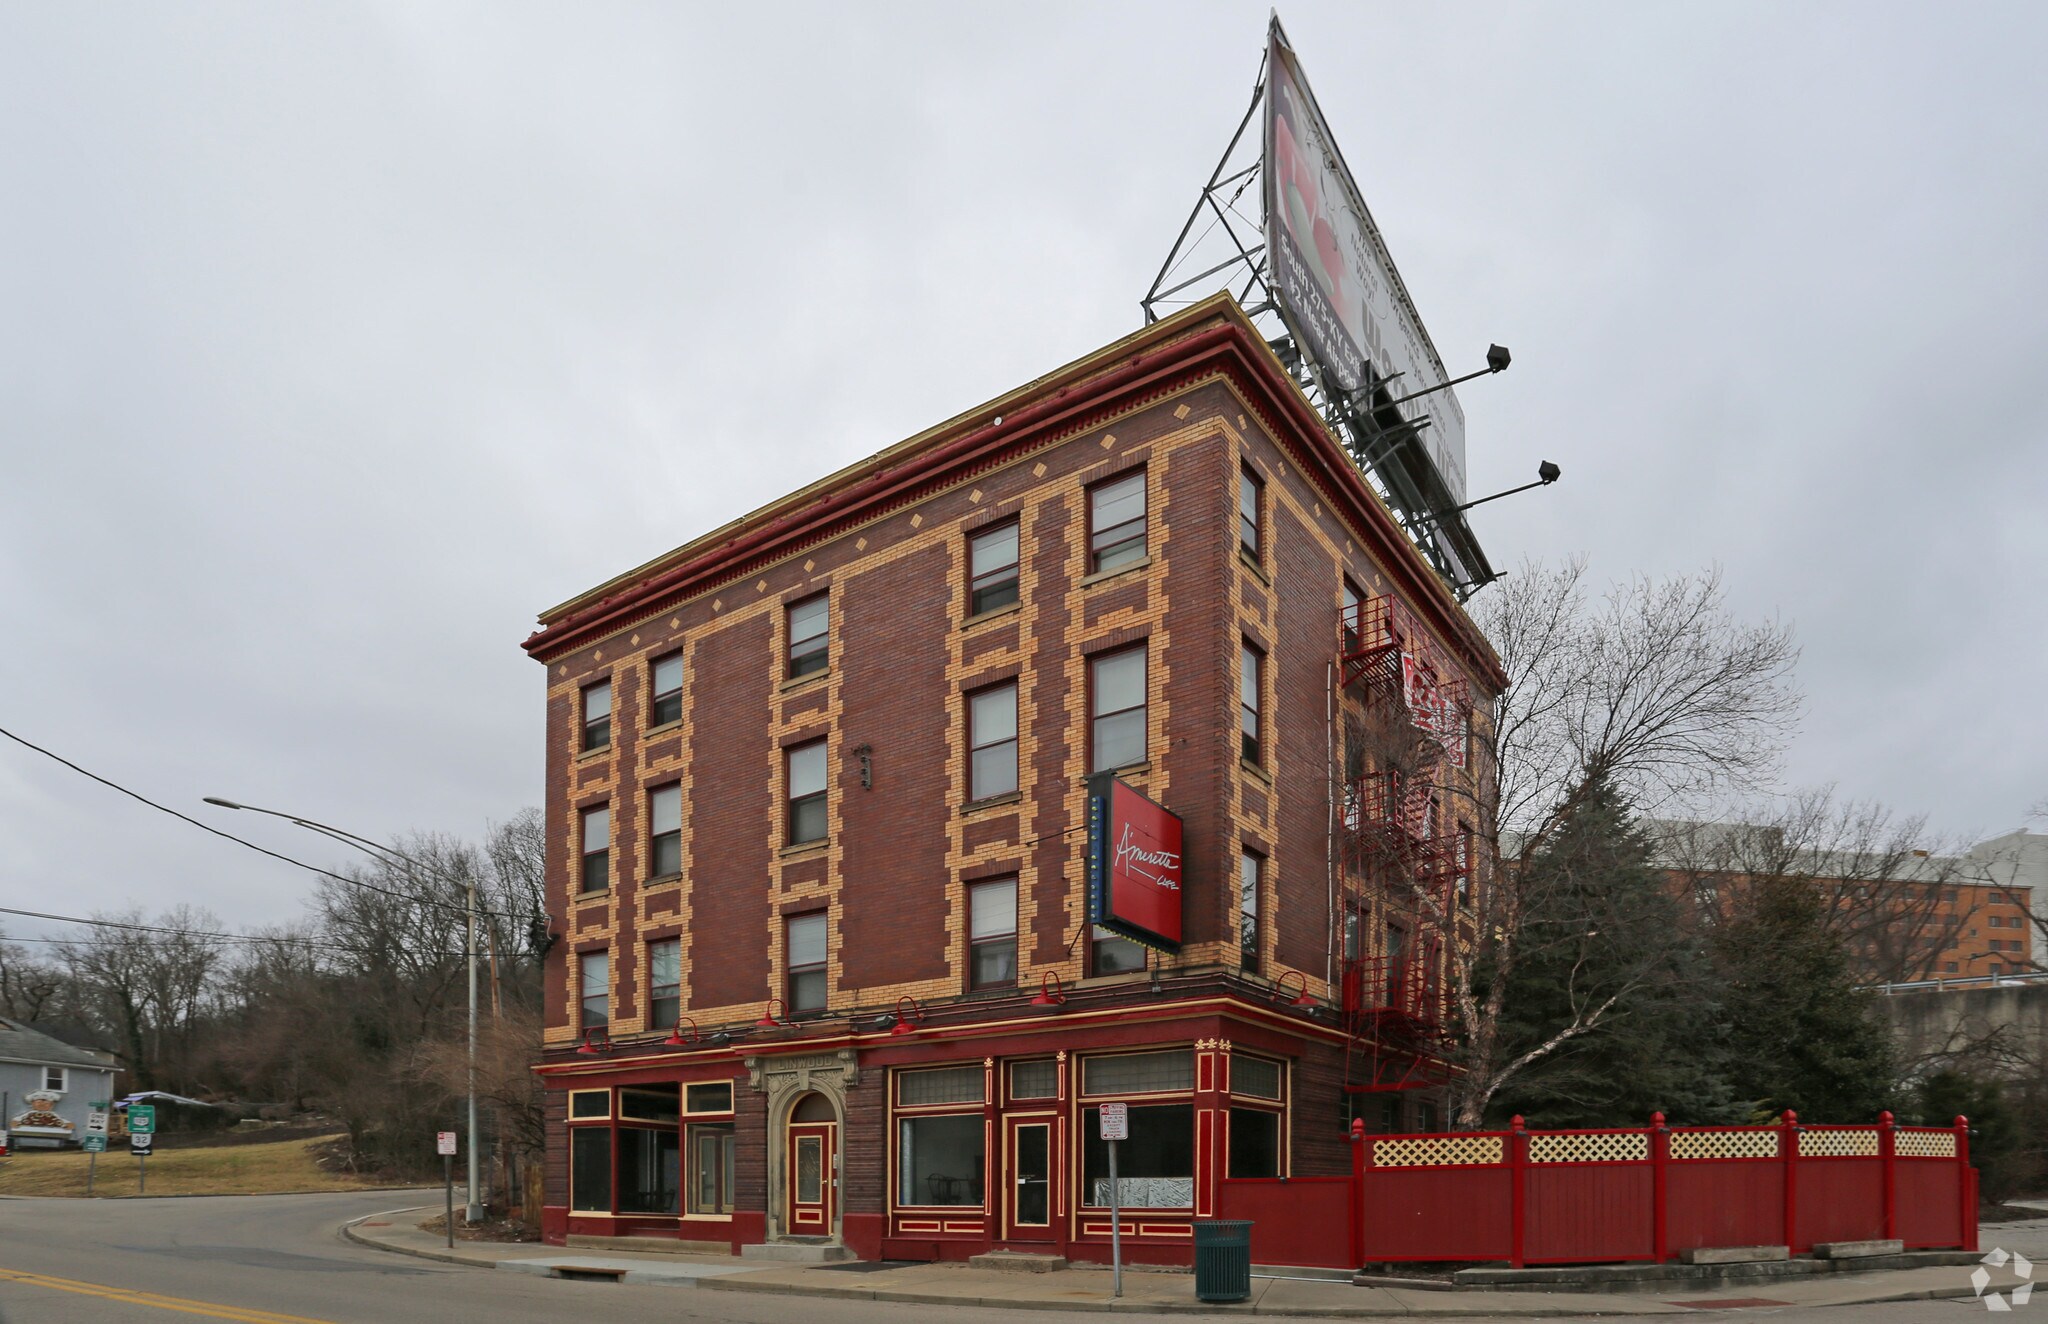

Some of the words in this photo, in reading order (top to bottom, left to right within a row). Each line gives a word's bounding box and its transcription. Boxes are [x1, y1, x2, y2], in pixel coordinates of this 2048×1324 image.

[1351, 233, 1378, 293] Natural
[1357, 225, 1371, 261] The
[1356, 260, 1375, 304] Way!
[1281, 234, 1309, 291] South
[1310, 283, 1344, 348] 275-KY
[1344, 341, 1361, 377] Exit
[1303, 298, 1325, 344] Near
[778, 1056, 833, 1070] LINWOOD
[135, 1136, 148, 1144] 32
